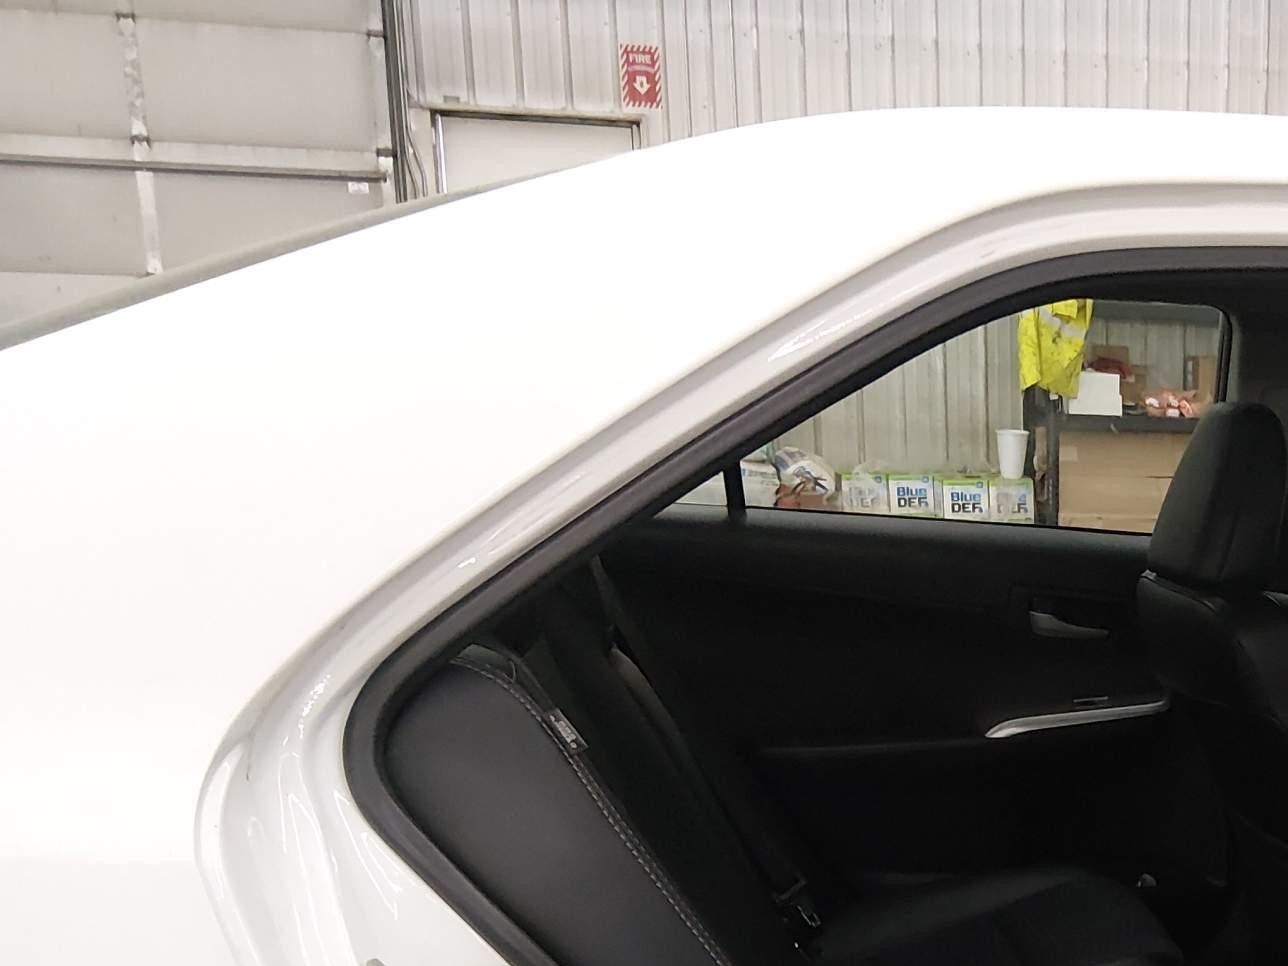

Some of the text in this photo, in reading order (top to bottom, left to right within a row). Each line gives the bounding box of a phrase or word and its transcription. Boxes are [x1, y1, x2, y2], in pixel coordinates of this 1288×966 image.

[628, 53, 652, 65] FIRE
[896, 485, 928, 497] Blue
[950, 491, 982, 502] Blue
